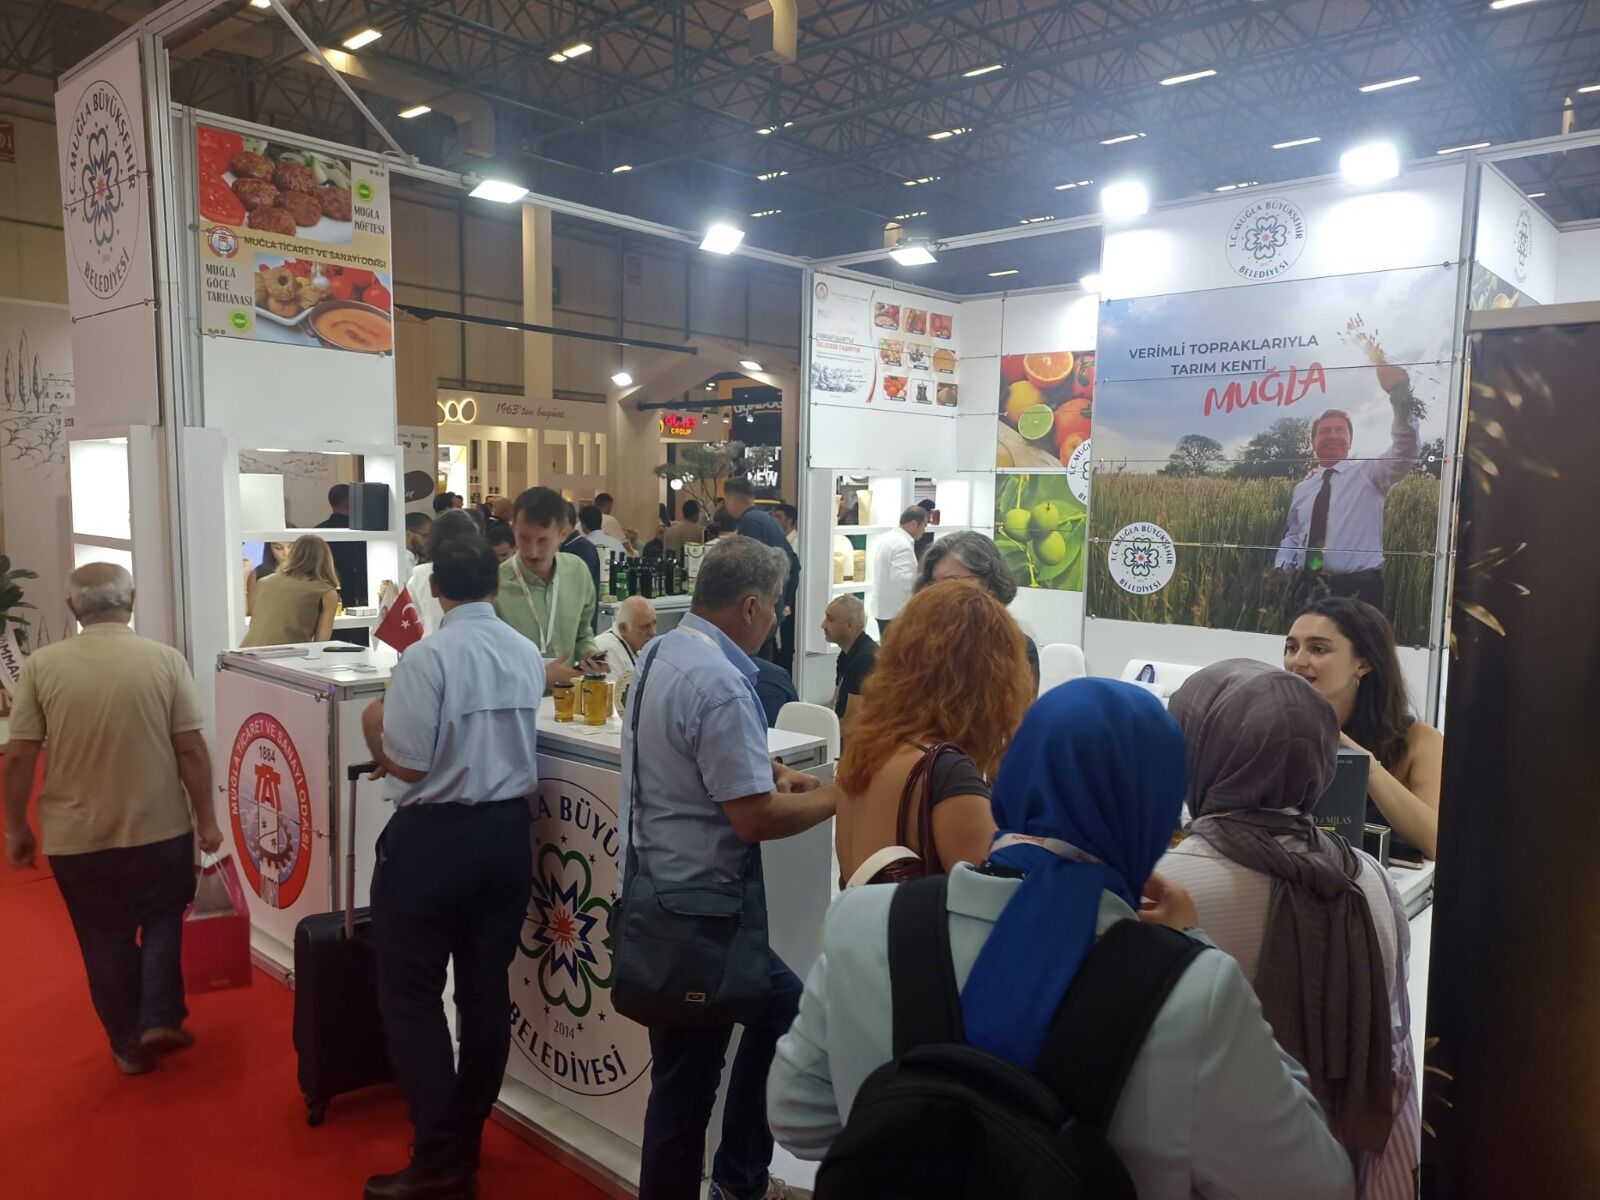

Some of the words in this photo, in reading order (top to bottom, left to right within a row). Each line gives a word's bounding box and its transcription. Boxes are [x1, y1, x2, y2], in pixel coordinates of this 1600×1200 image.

[69, 103, 92, 174] MUĞLA
[279, 240, 315, 256] TİCARET
[317, 247, 327, 257] VE
[83, 246, 131, 293] BELEDİYESİ
[206, 291, 253, 307] TARHANASI
[1129, 342, 1186, 360] VERİMLİ
[1188, 334, 1319, 355] TOPRAKLARIYLA
[1170, 361, 1217, 376] TARIM
[1220, 356, 1267, 373] KENTİ
[1203, 361, 1327, 417] MUĞLA
[258, 744, 277, 764] 1884
[237, 719, 265, 754] TİCARET
[265, 721, 277, 739] VE
[299, 788, 310, 851] ODASI
[553, 1019, 575, 1040] 2014
[510, 1001, 628, 1086] BELEDİYESİ
